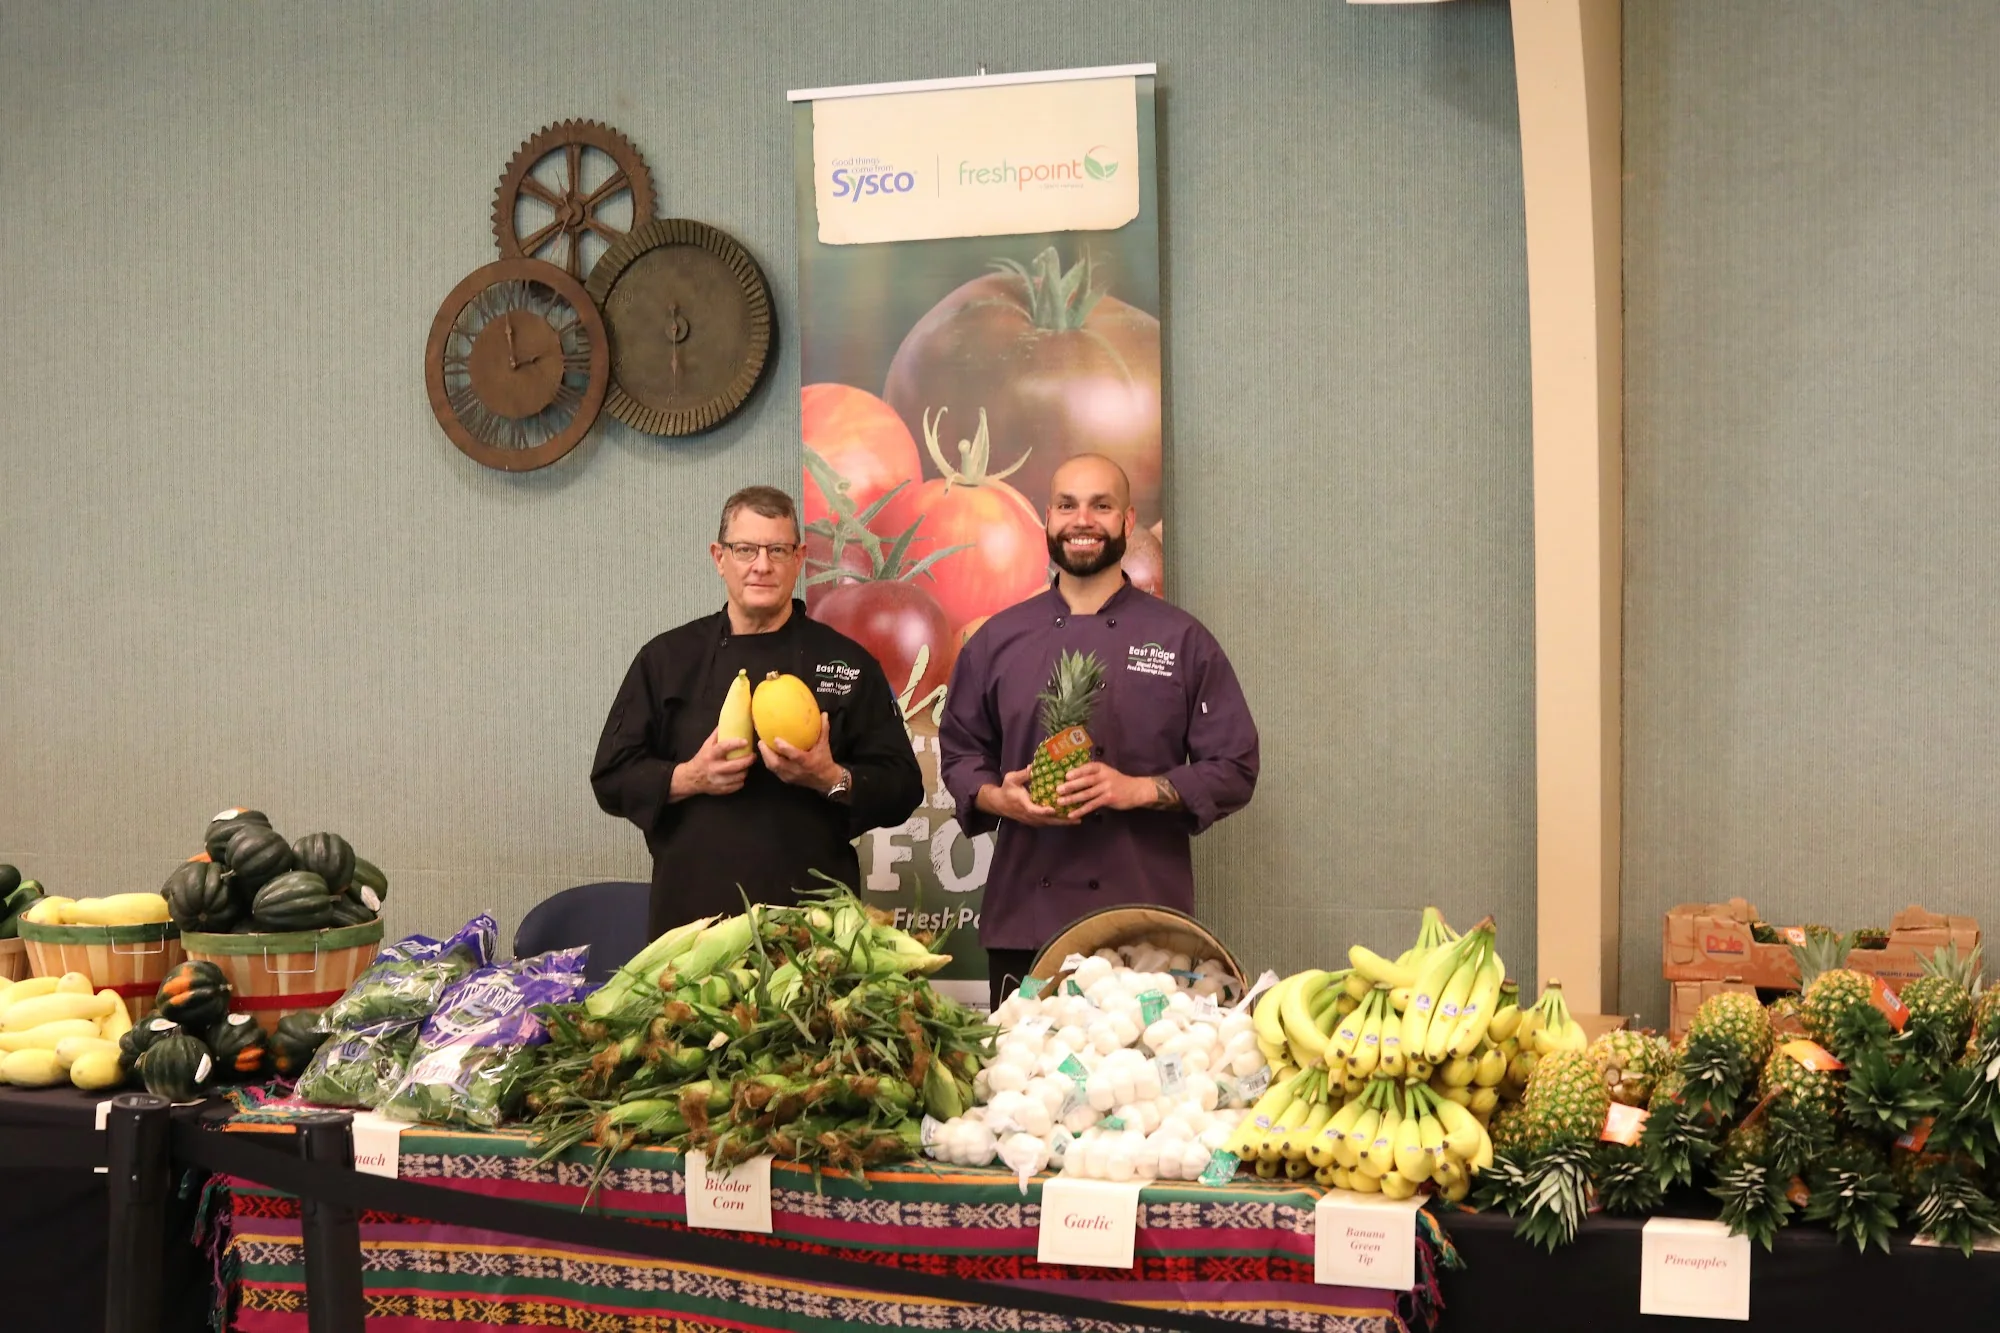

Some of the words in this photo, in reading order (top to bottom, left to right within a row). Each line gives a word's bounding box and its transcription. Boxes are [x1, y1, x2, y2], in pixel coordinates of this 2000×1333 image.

[832, 158, 854, 166] Good
[855, 157, 881, 166] things
[959, 158, 1083, 192] freshpoint
[832, 168, 915, 203] Sysco
[1129, 646, 1148, 657] East
[1150, 648, 1175, 661] Ridge
[816, 664, 834, 673] East
[836, 665, 860, 677] Ridge
[1706, 935, 1743, 952] Dole
[483, 984, 525, 1016] FRESH
[705, 1178, 752, 1193] Bicolor
[713, 1196, 745, 1211] Corn
[1064, 1213, 1114, 1230] Garlic
[1346, 1227, 1386, 1239] Banana
[1350, 1240, 1381, 1252] Green
[1358, 1253, 1374, 1267] Tip
[1664, 1254, 1728, 1270] Pineapples
